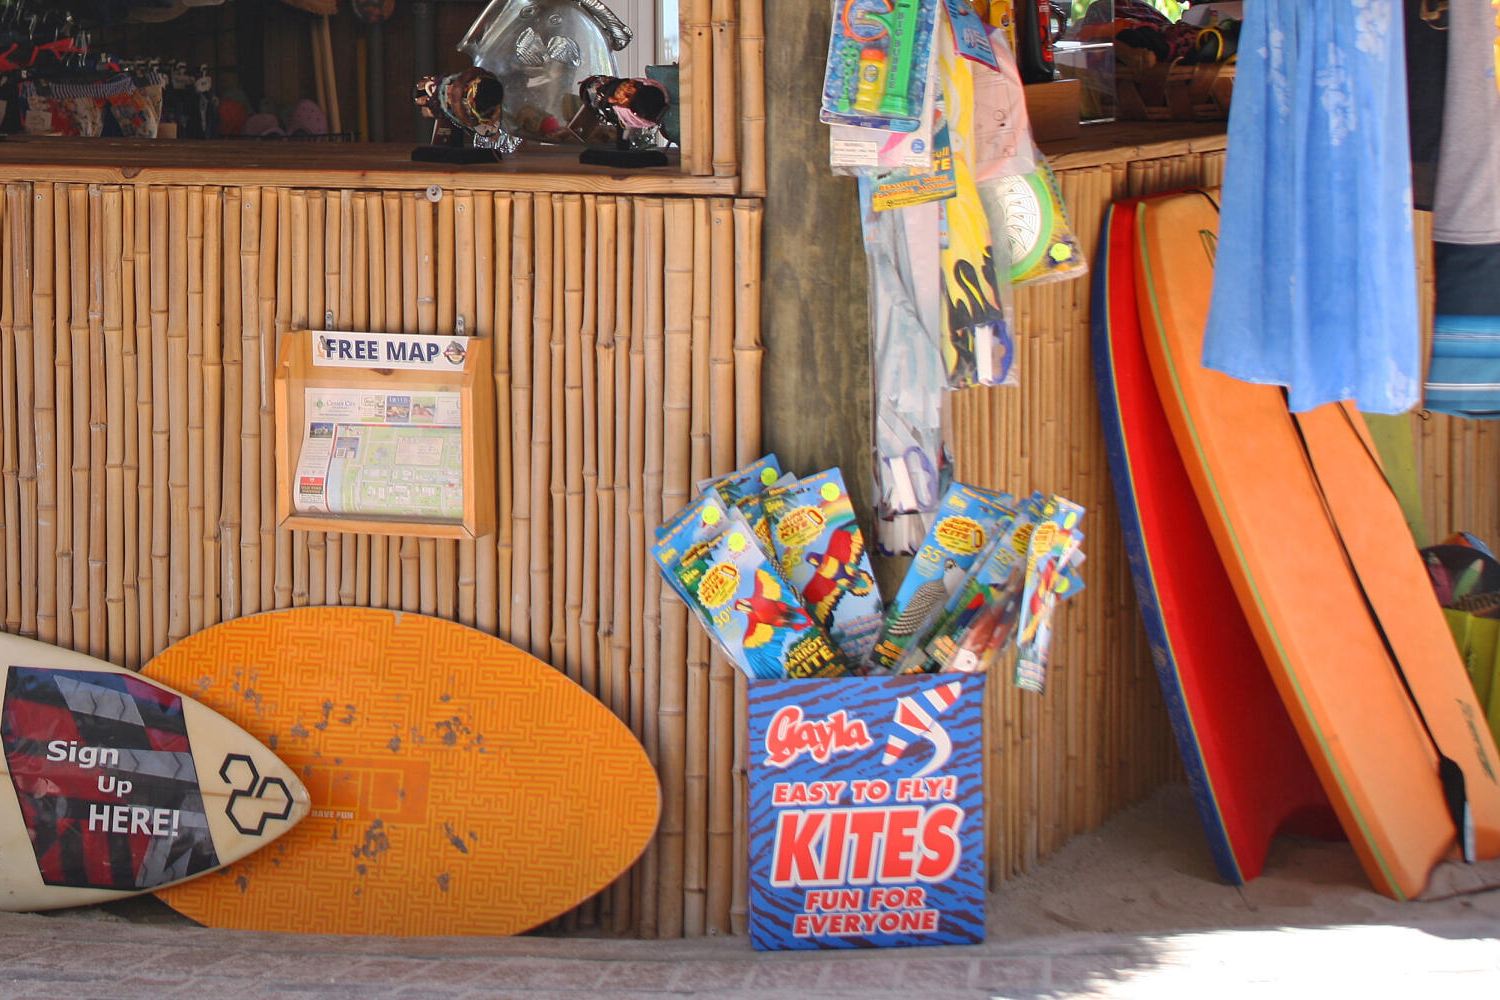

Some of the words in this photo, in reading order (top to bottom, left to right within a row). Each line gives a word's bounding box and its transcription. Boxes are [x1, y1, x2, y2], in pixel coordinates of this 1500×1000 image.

[326, 338, 379, 361] FREE
[386, 341, 440, 363] MAP
[784, 635, 824, 670] PARROT
[790, 645, 835, 678] KITE
[766, 706, 872, 766] Gayla
[46, 740, 119, 769] Sign
[97, 775, 133, 798] Up
[773, 781, 845, 805] EASY
[852, 780, 889, 803] TO
[897, 776, 956, 801] FLY!
[88, 803, 180, 837] HERE!
[311, 809, 334, 818] HAVE
[772, 805, 964, 885] KITES
[806, 888, 862, 911] FUN
[869, 886, 925, 909] FOR
[794, 910, 938, 936] EVERYONE
